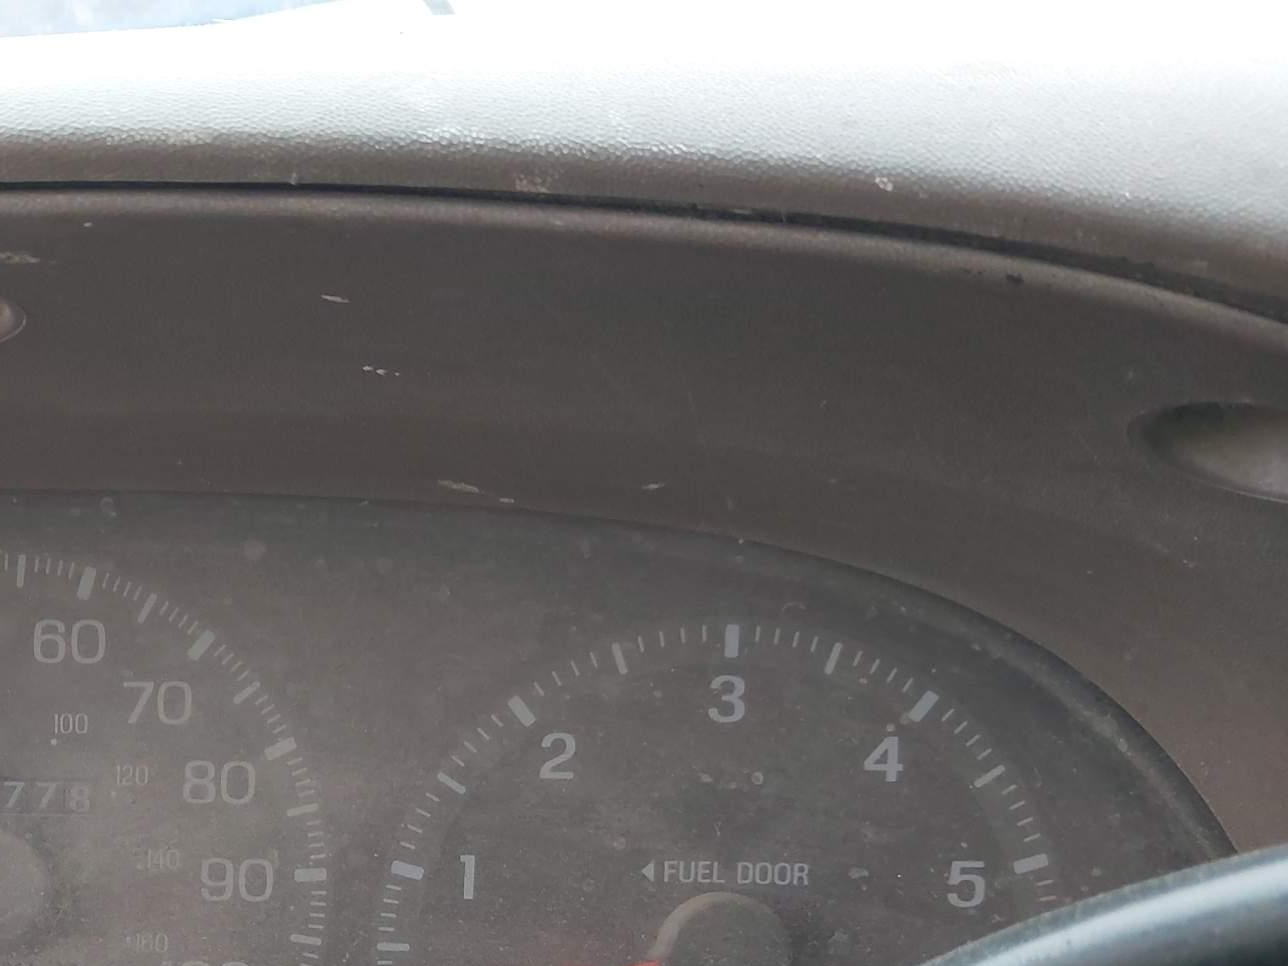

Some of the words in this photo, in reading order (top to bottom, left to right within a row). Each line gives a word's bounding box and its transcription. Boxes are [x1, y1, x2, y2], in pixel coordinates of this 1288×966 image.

[32, 618, 106, 664] 60
[123, 680, 192, 725] 70
[709, 674, 746, 724] 3
[53, 712, 88, 736] 100
[114, 762, 149, 786] 120
[538, 732, 577, 781] 2
[863, 735, 905, 783] 4
[182, 760, 256, 805] 80
[200, 856, 274, 903] 90
[458, 853, 476, 900] 1
[662, 861, 726, 885] FUEL
[737, 861, 809, 886] DOOR
[947, 859, 986, 908] 5
